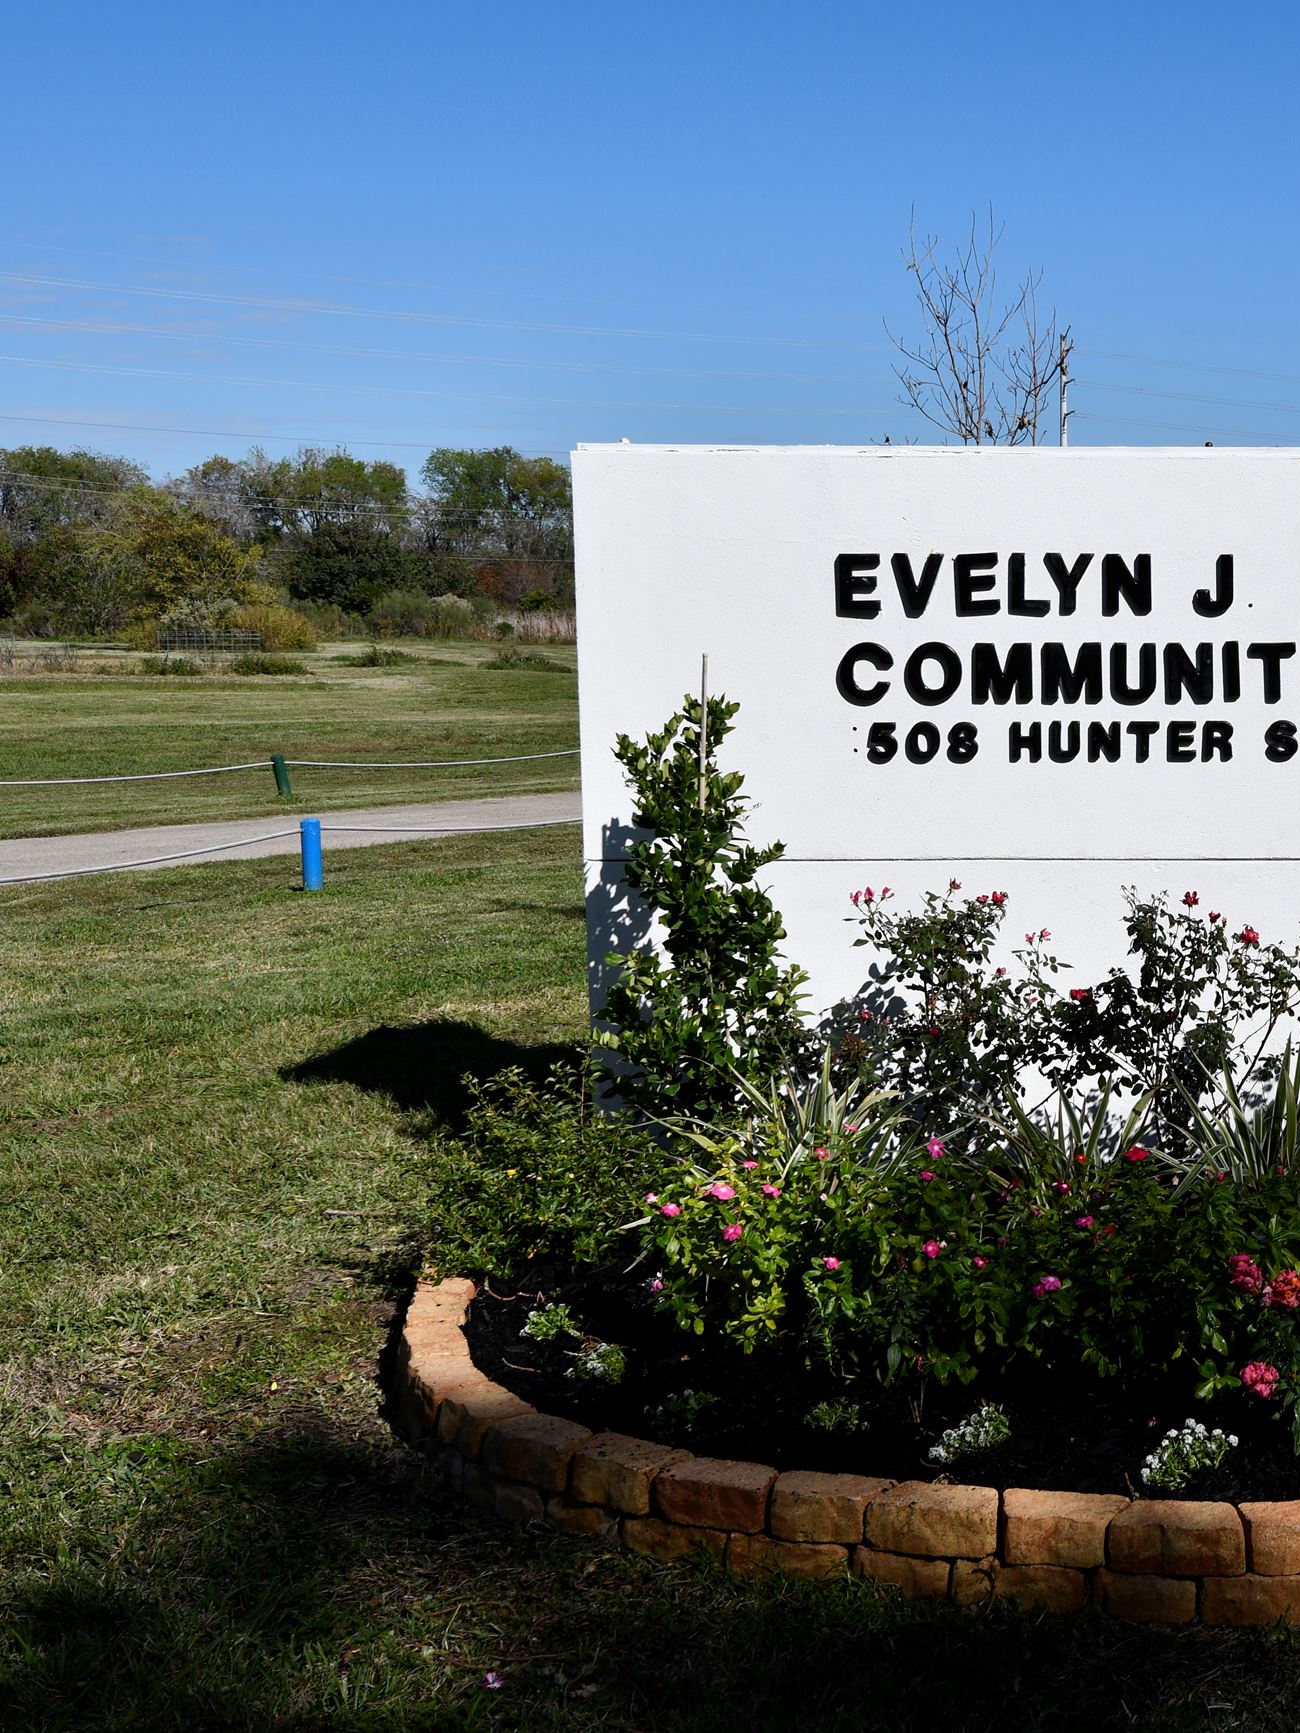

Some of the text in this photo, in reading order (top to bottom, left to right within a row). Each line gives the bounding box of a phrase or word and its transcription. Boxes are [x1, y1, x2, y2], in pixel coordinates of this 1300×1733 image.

[833, 552, 1152, 619] EVELYN
[867, 721, 979, 765] 508
[1008, 720, 1234, 764] HUNTER
